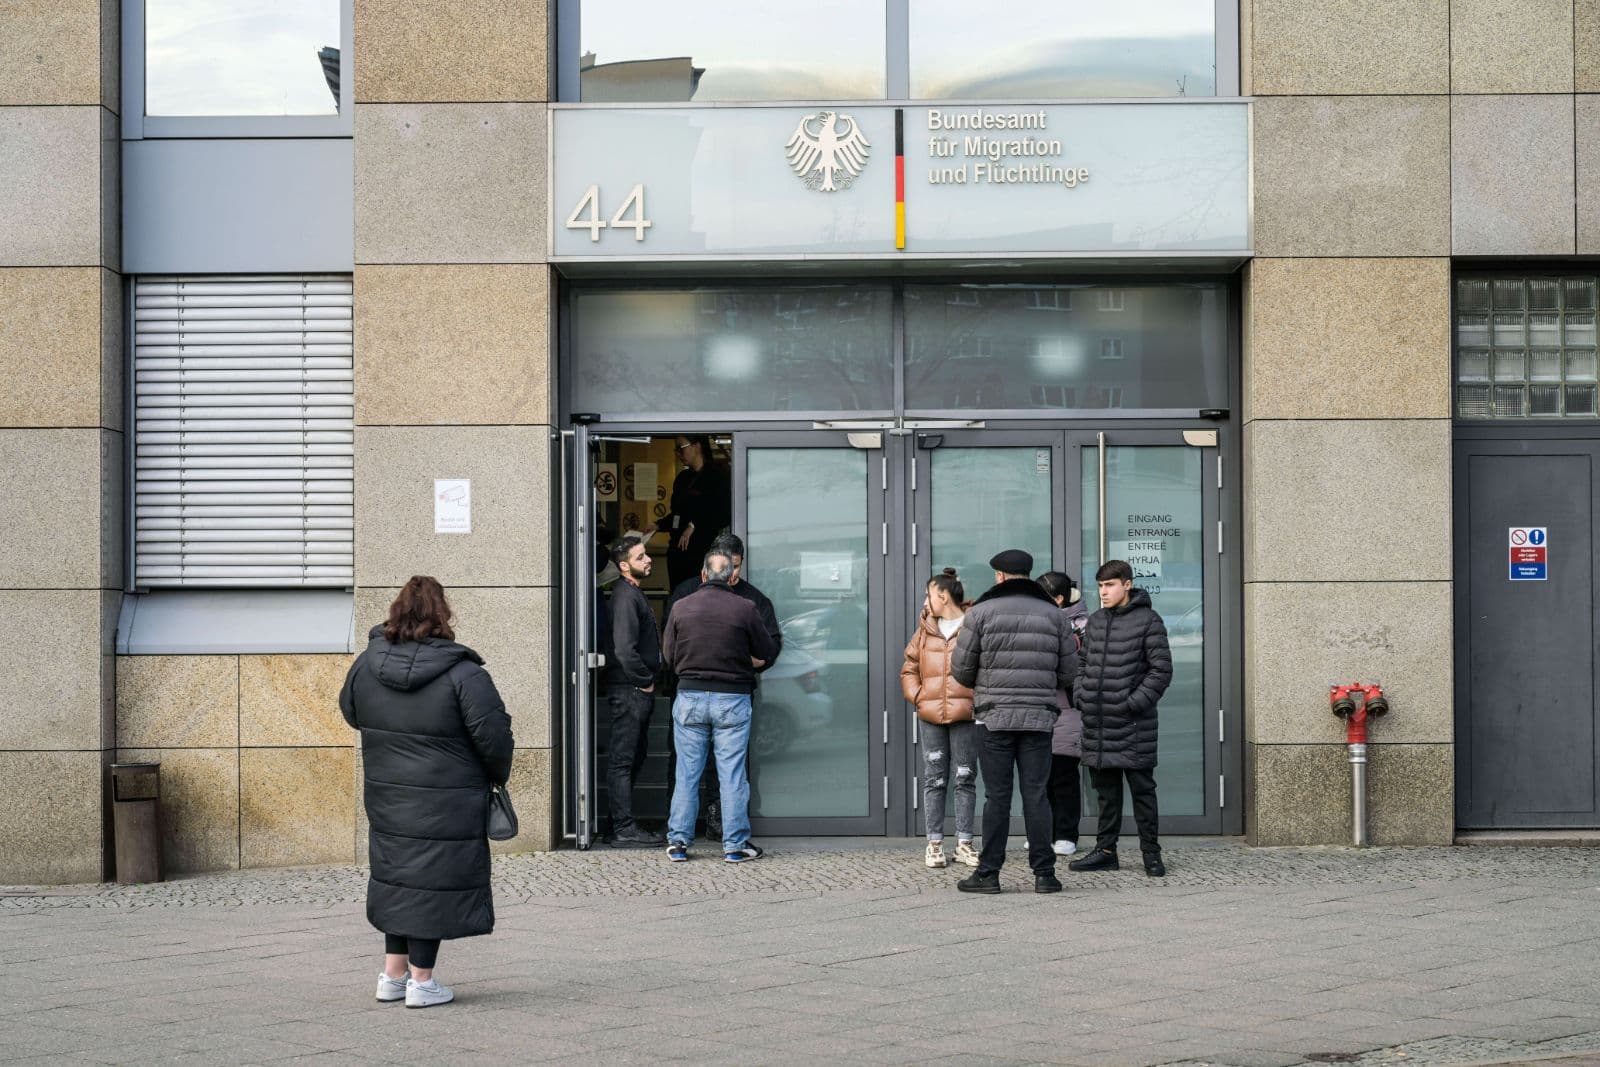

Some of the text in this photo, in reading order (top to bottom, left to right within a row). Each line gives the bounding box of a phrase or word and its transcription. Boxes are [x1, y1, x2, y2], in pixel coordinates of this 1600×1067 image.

[928, 109, 1047, 130] Bundesamt
[929, 136, 1062, 161] für Migration
[929, 162, 1089, 188] und Flüchtlinge
[565, 183, 652, 242] 44
[1128, 514, 1172, 523] EINGANG
[1128, 528, 1181, 537] ENTRANCE
[1128, 556, 1160, 564] HYRJA
